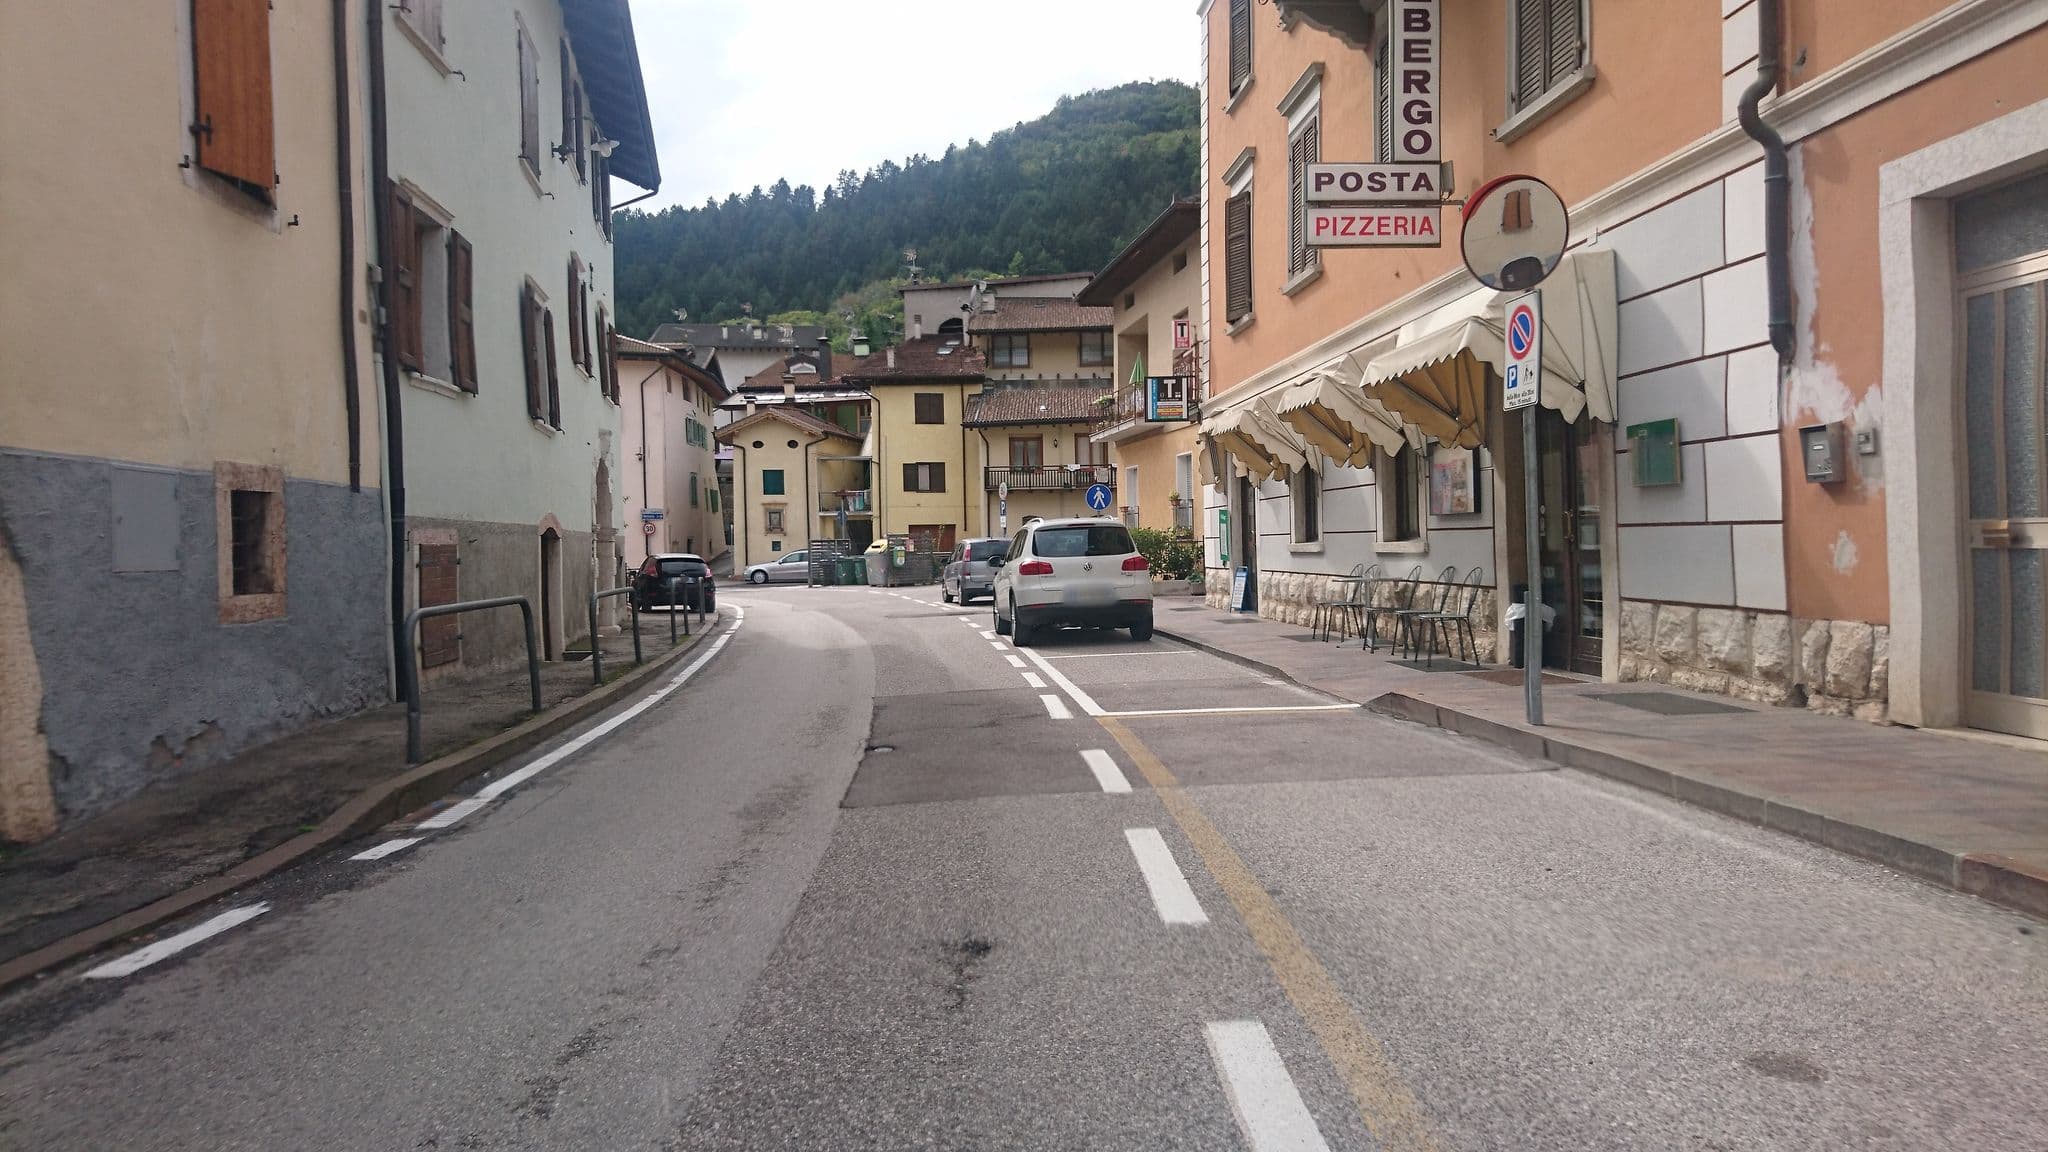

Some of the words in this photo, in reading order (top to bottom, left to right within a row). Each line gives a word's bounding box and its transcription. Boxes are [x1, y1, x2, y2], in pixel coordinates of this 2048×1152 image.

[1402, 0, 1432, 155] BERGO
[1315, 172, 1434, 193] POSTA
[1316, 216, 1434, 237] PIZZERIA
[1178, 323, 1187, 337] T
[1509, 368, 1516, 387] P
[1164, 380, 1176, 398] T
